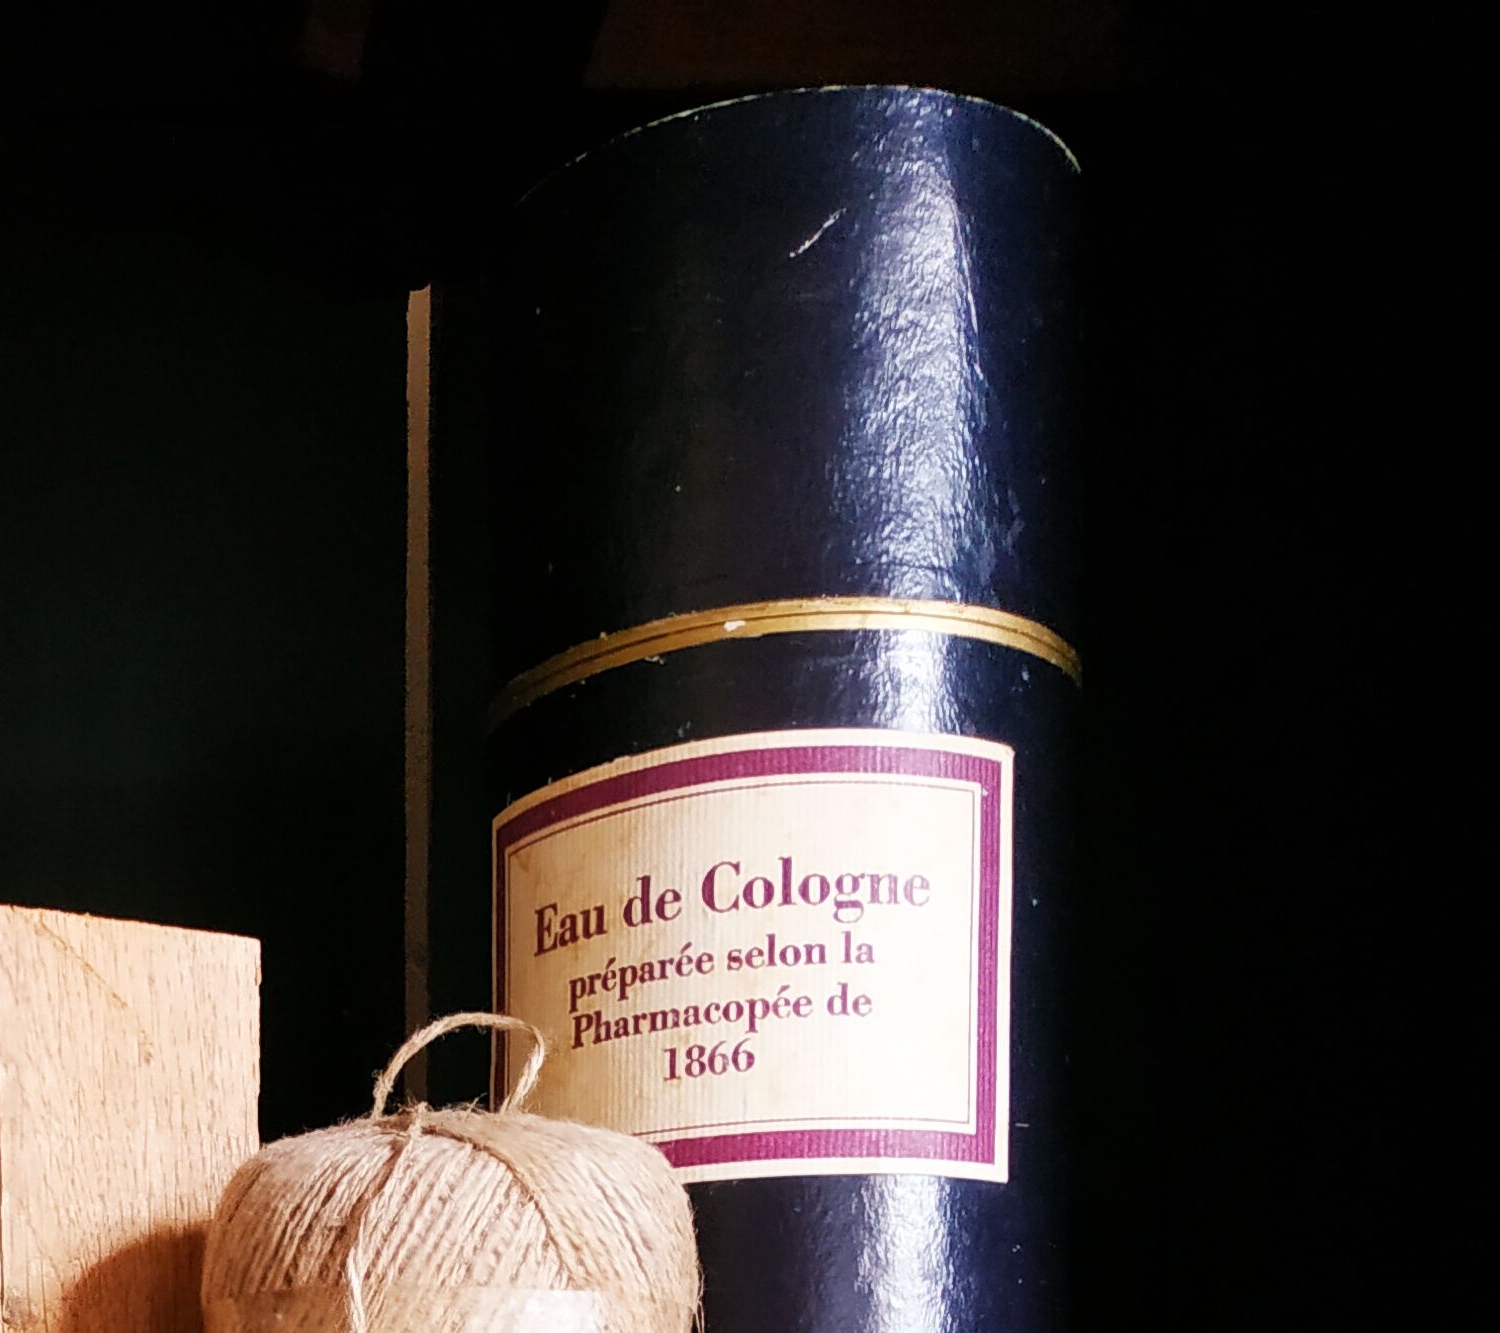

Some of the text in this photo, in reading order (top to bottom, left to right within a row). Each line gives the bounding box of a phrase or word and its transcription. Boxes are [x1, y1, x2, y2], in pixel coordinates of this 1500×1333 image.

[533, 856, 931, 957] Eau de Cologne
[568, 931, 876, 1013] préparée selon la
[570, 982, 874, 1049] Pharmacopée de
[662, 1038, 756, 1081] 1866
